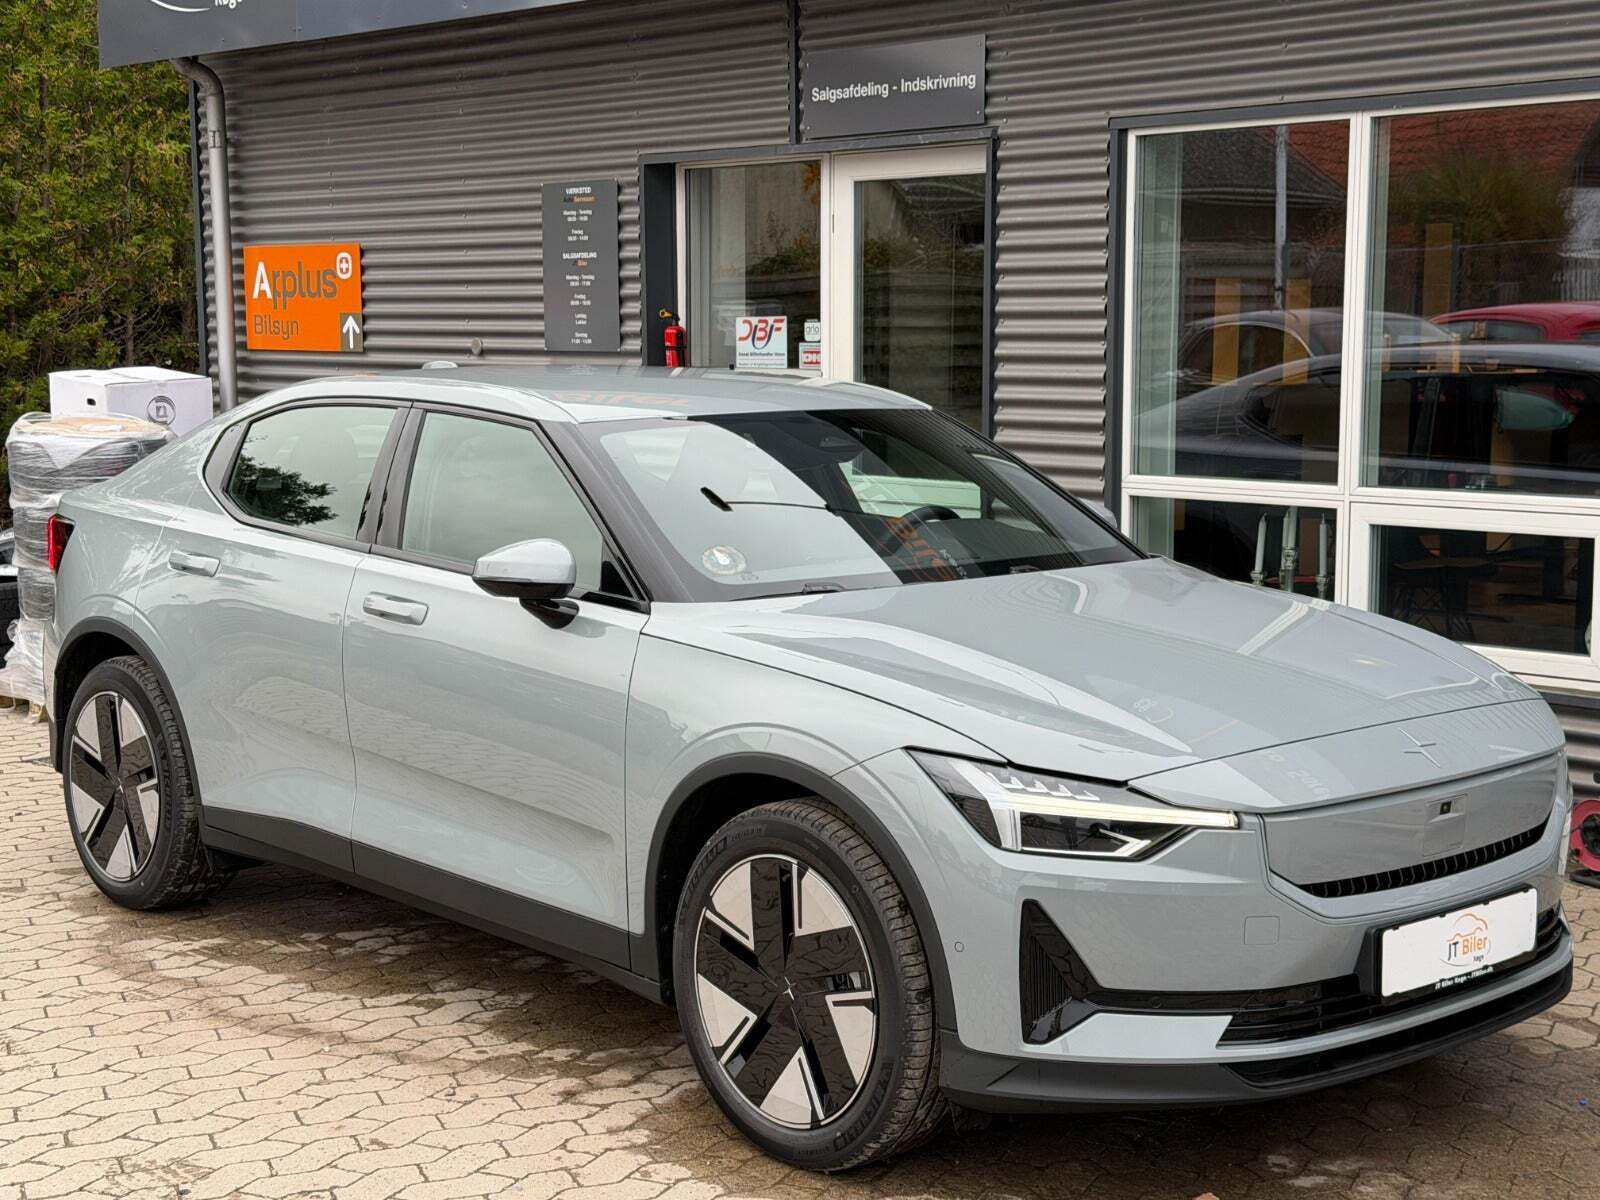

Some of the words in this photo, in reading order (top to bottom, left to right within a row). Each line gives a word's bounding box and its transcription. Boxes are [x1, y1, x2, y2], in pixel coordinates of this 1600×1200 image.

[811, 82, 889, 103] Salgsafdeling
[900, 73, 976, 94] Indskrivning
[254, 314, 299, 340] Bilsyn
[1448, 941, 1459, 961] JT
[1463, 937, 1487, 954] Biler
